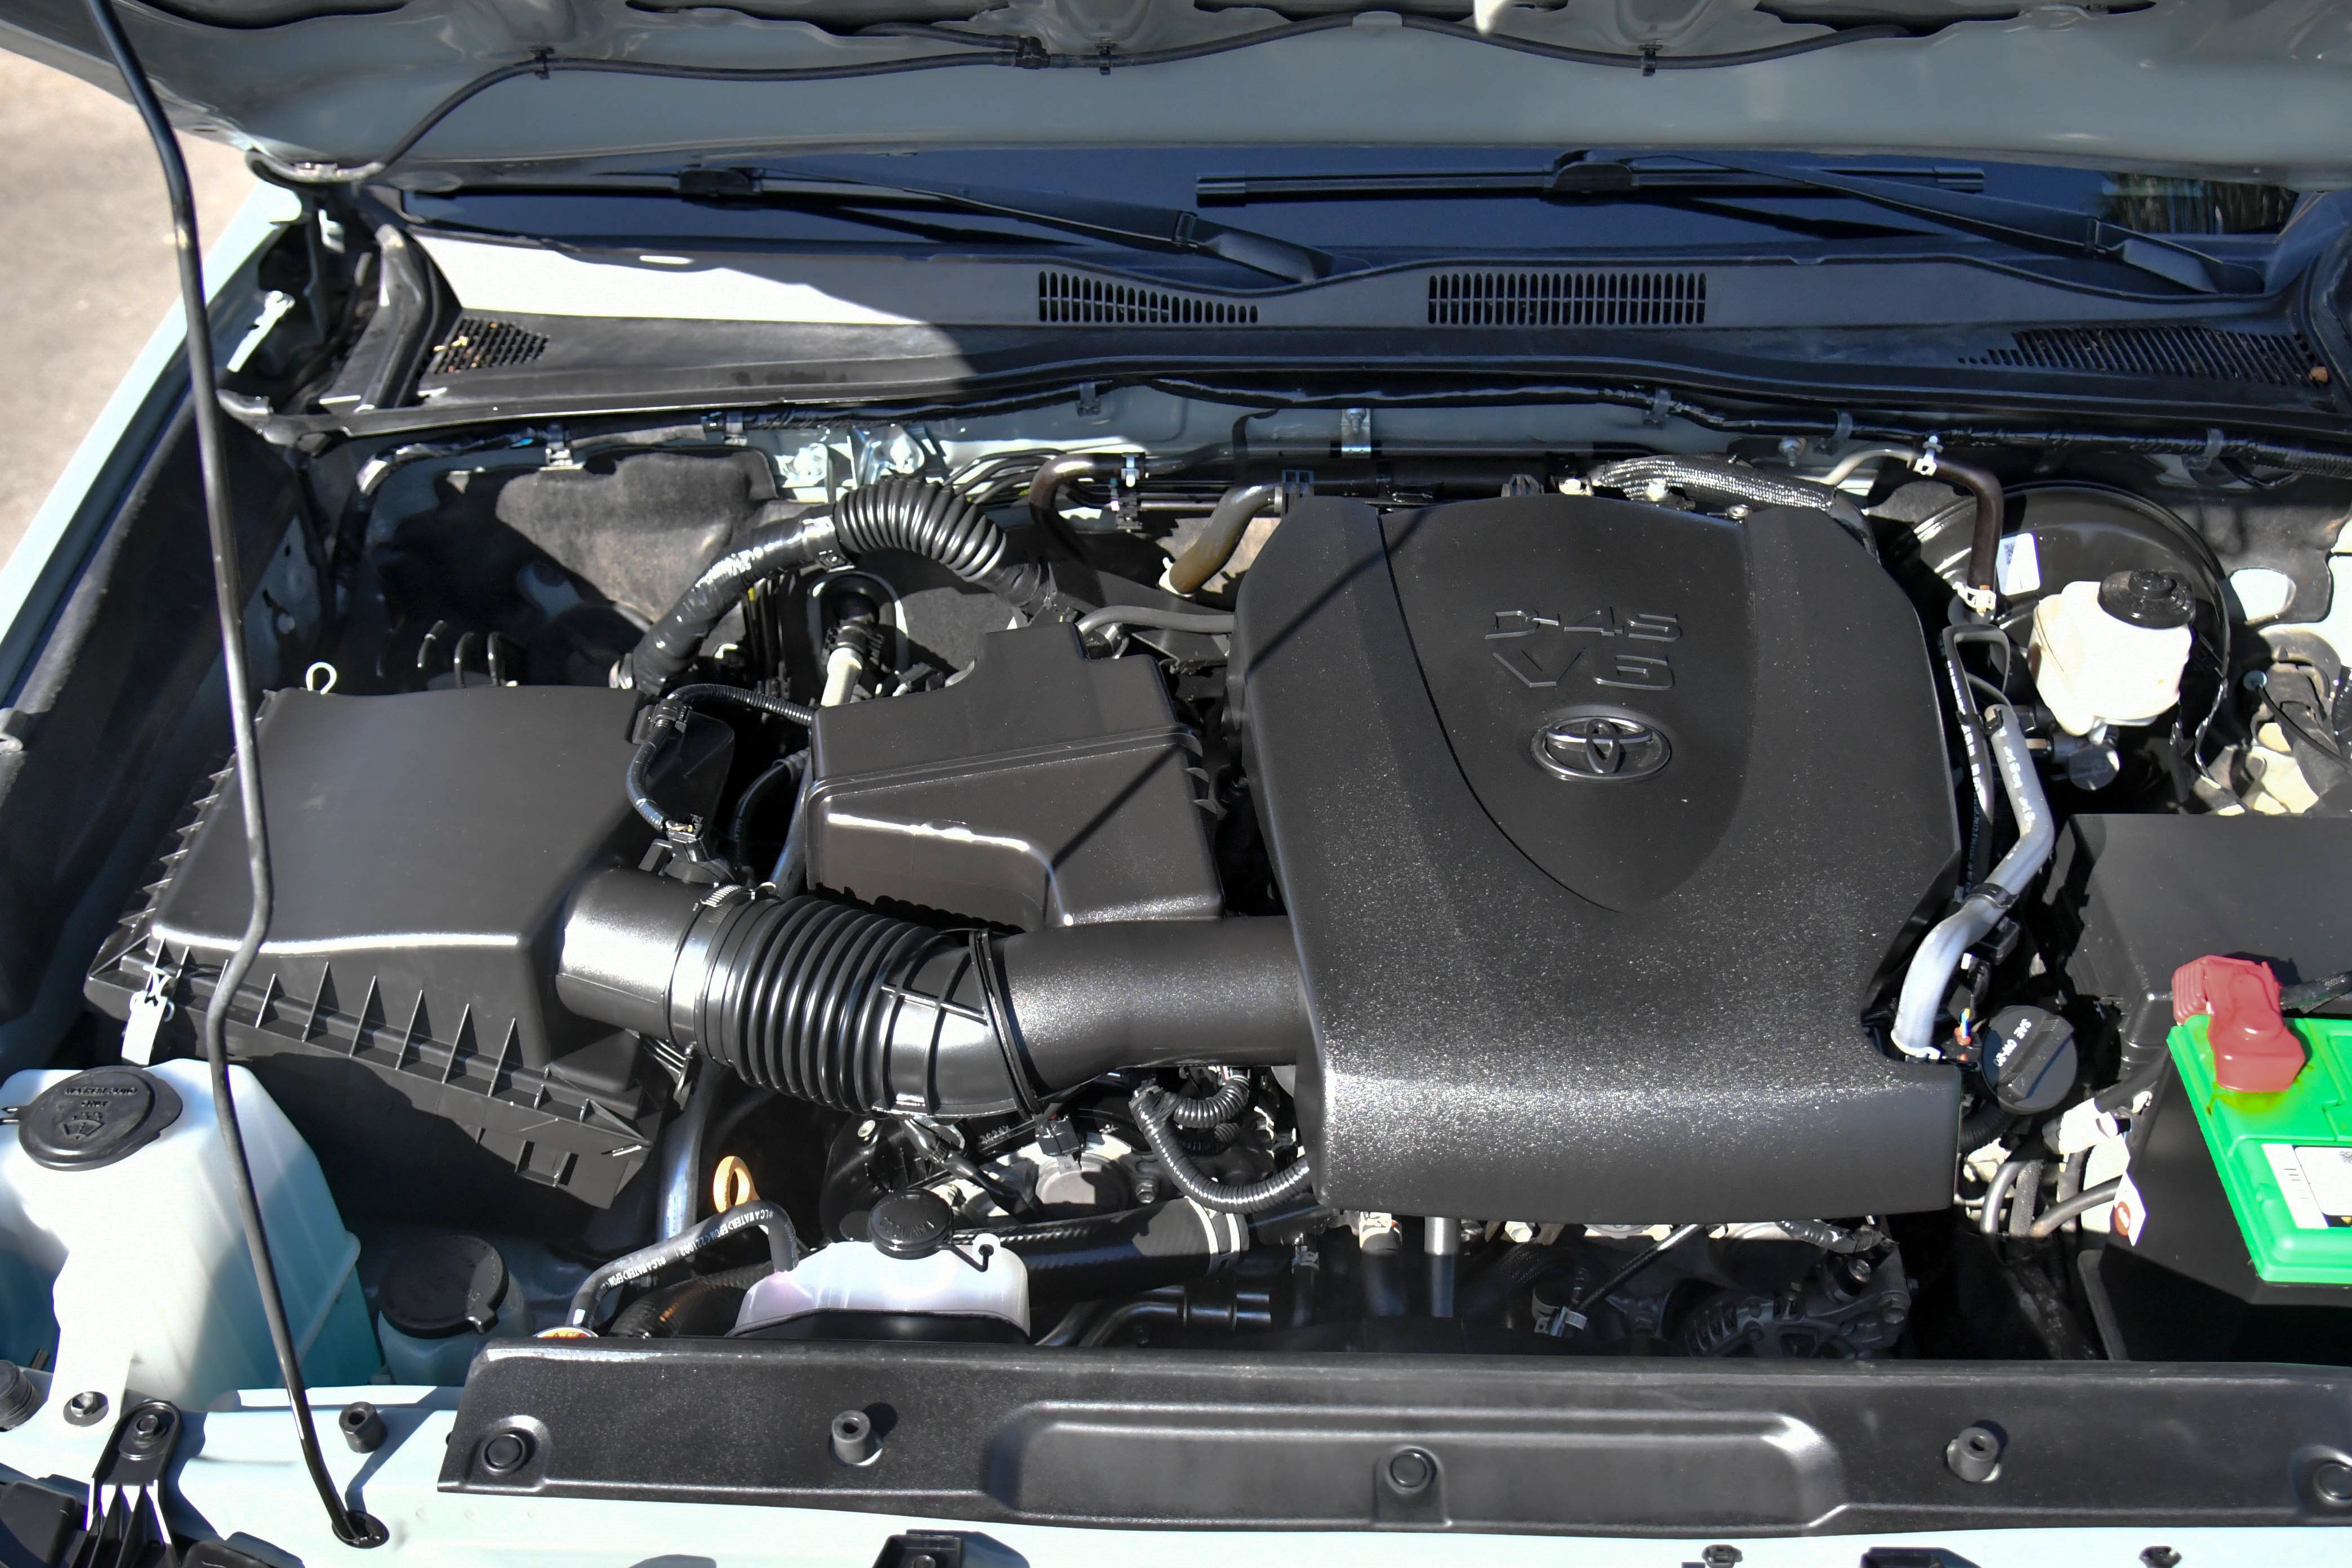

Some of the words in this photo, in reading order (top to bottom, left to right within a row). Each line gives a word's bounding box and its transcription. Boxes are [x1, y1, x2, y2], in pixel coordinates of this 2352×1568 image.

[1485, 606, 1683, 642] D-4S
[1492, 647, 1676, 691] V6
[2014, 1018, 2032, 1039] SAE
[64, 1086, 106, 1095] WASHER
[880, 1217, 935, 1240] COOLANT
